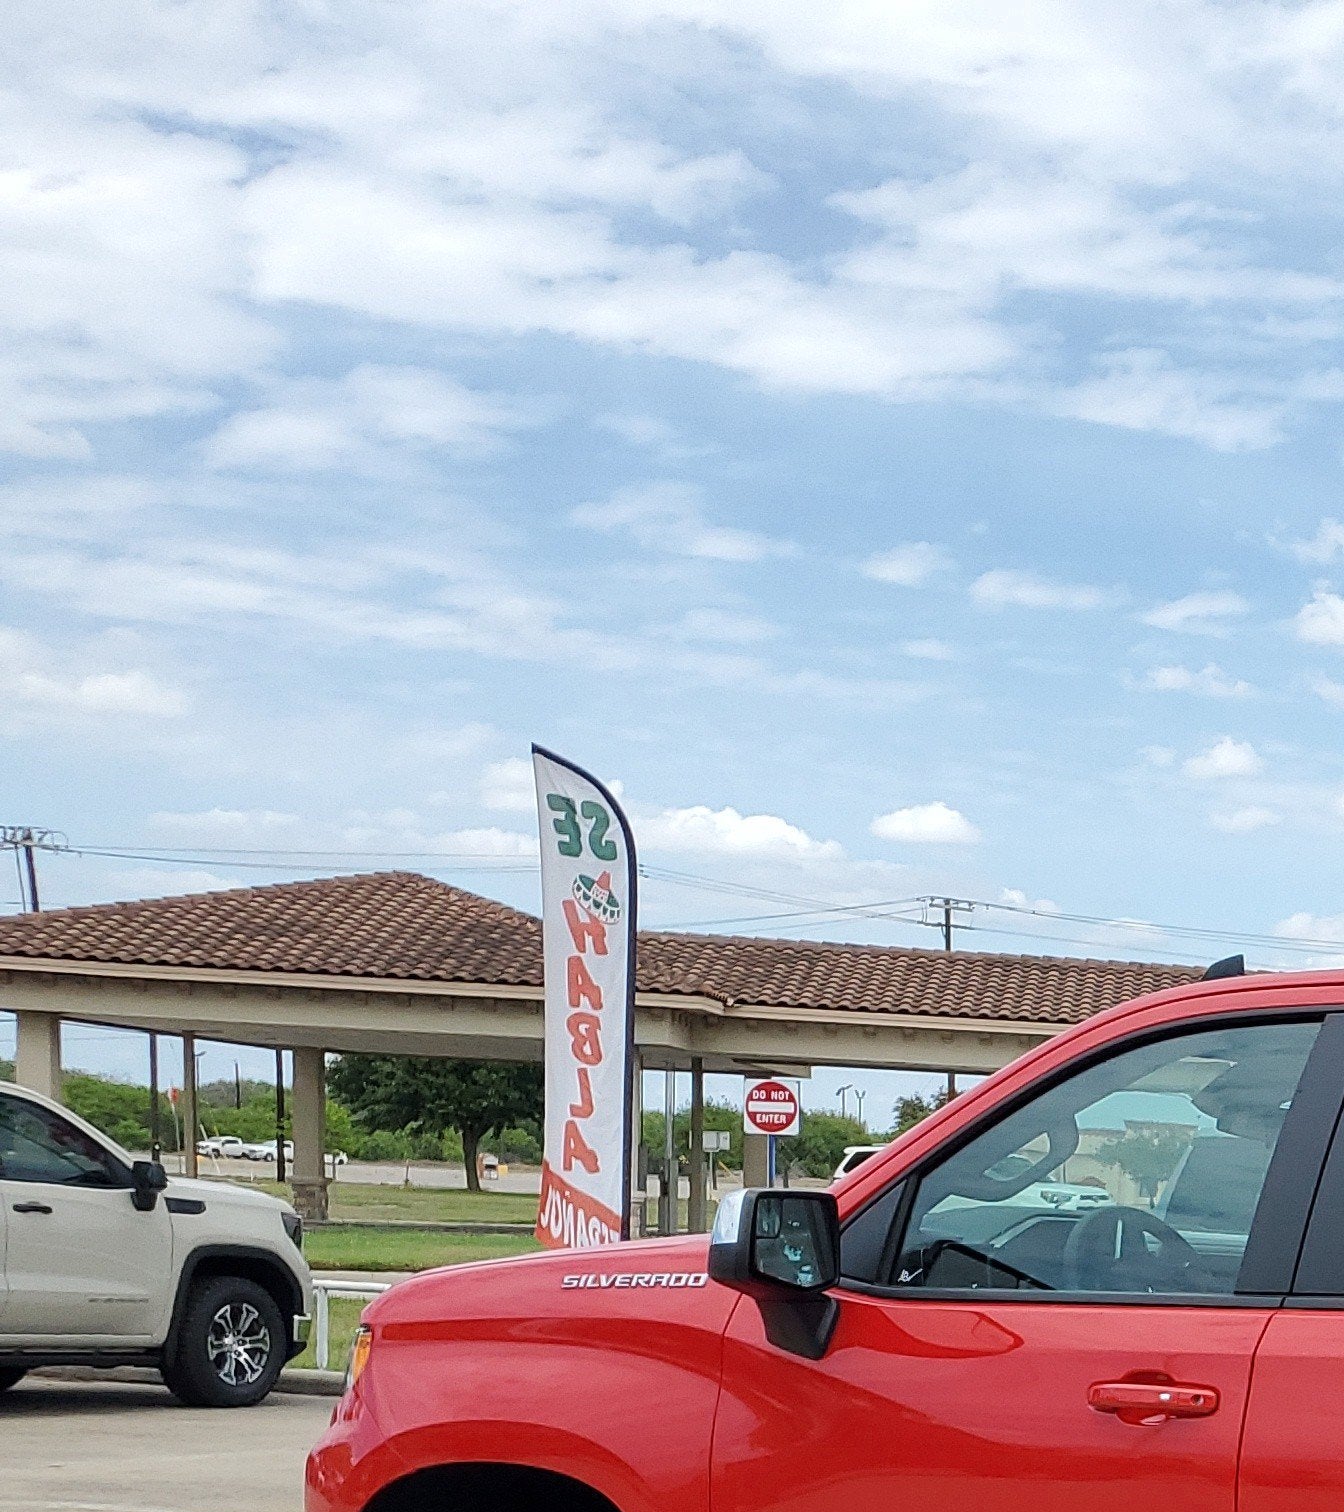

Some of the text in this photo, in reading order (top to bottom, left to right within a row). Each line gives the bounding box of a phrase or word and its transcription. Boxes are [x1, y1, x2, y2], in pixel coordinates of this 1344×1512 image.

[752, 1089, 790, 1100] DO NOT
[756, 1113, 787, 1124] ENTER
[561, 1272, 709, 1288] SILVERADO
